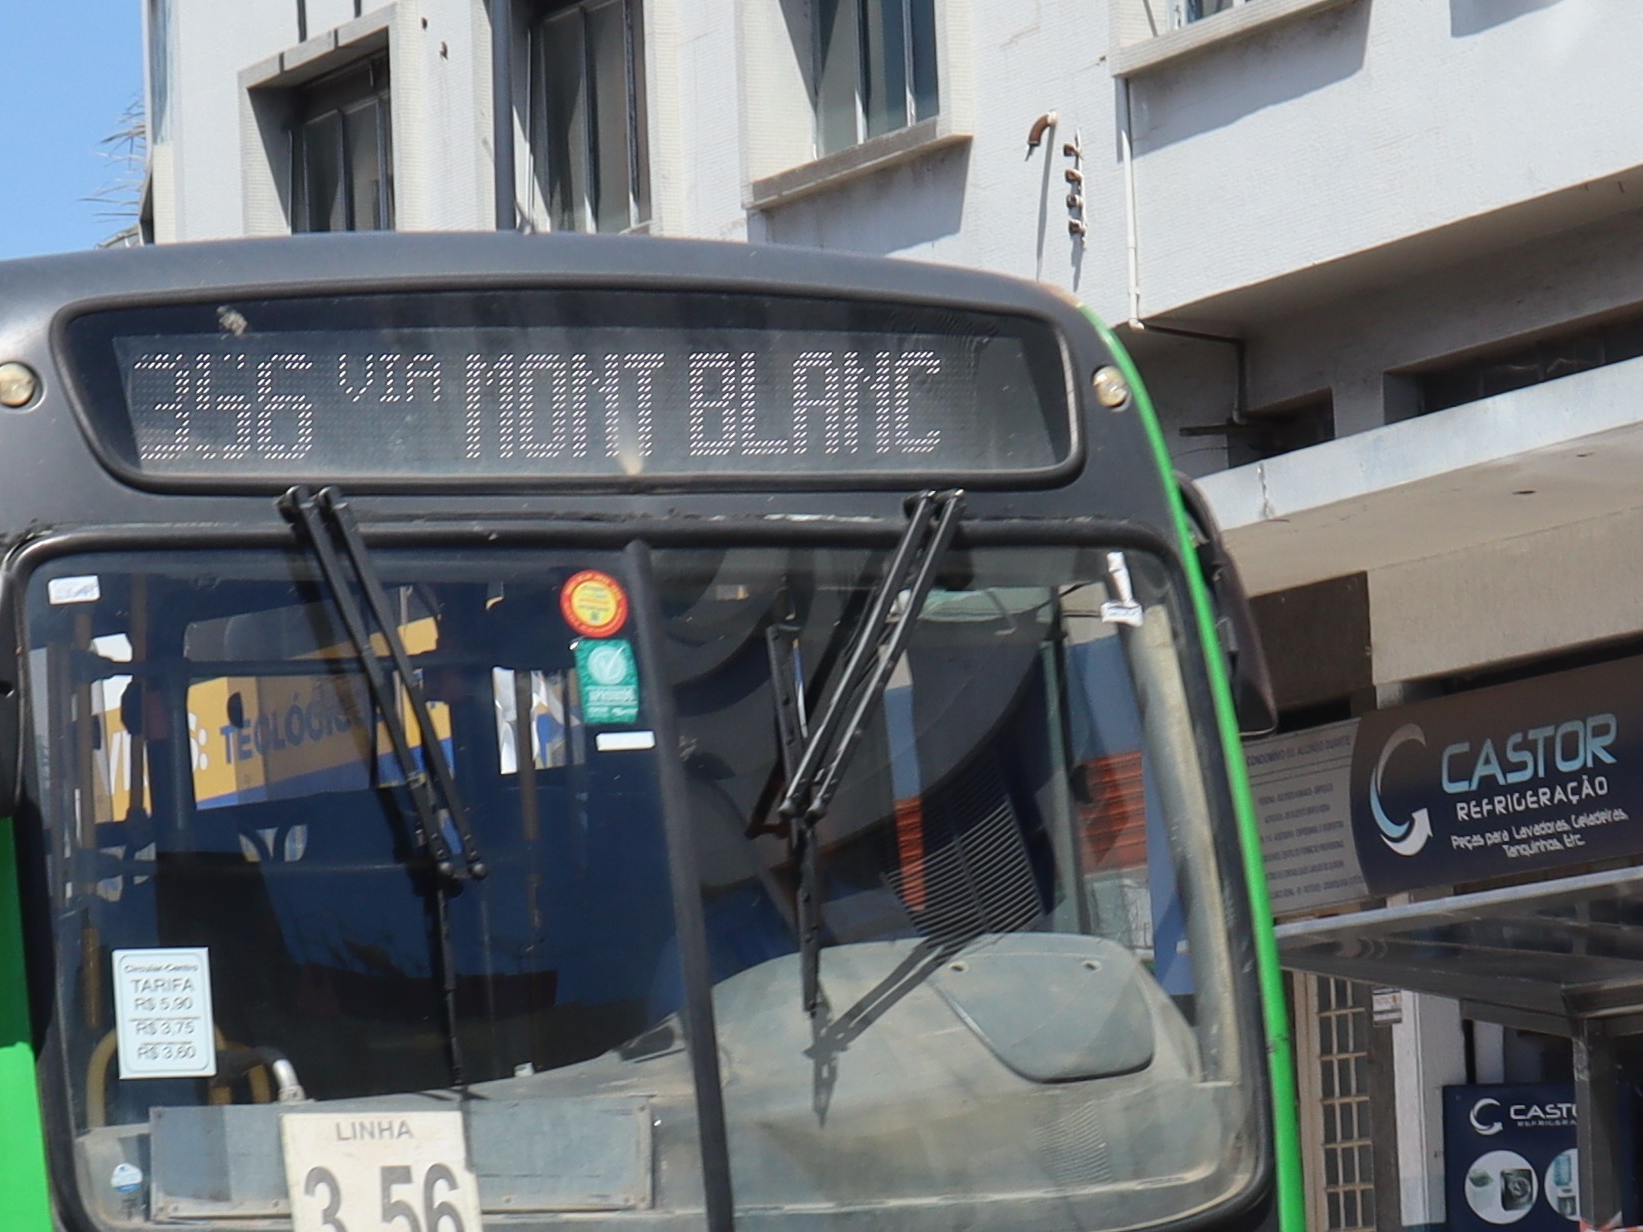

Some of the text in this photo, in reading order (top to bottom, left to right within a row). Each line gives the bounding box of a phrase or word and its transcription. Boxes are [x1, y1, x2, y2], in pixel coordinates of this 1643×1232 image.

[337, 354, 442, 403] VIA
[465, 353, 666, 459] MONT
[689, 351, 942, 457] BLANC
[1441, 713, 1617, 793] CASTOR
[1456, 775, 1609, 822] REFRIGERAÇÃO
[130, 978, 195, 993] TARIFA
[134, 996, 156, 1011] R$
[135, 1020, 195, 1035] R$ 3,75
[137, 1045, 159, 1060] R$
[335, 1119, 414, 1142] LINHA
